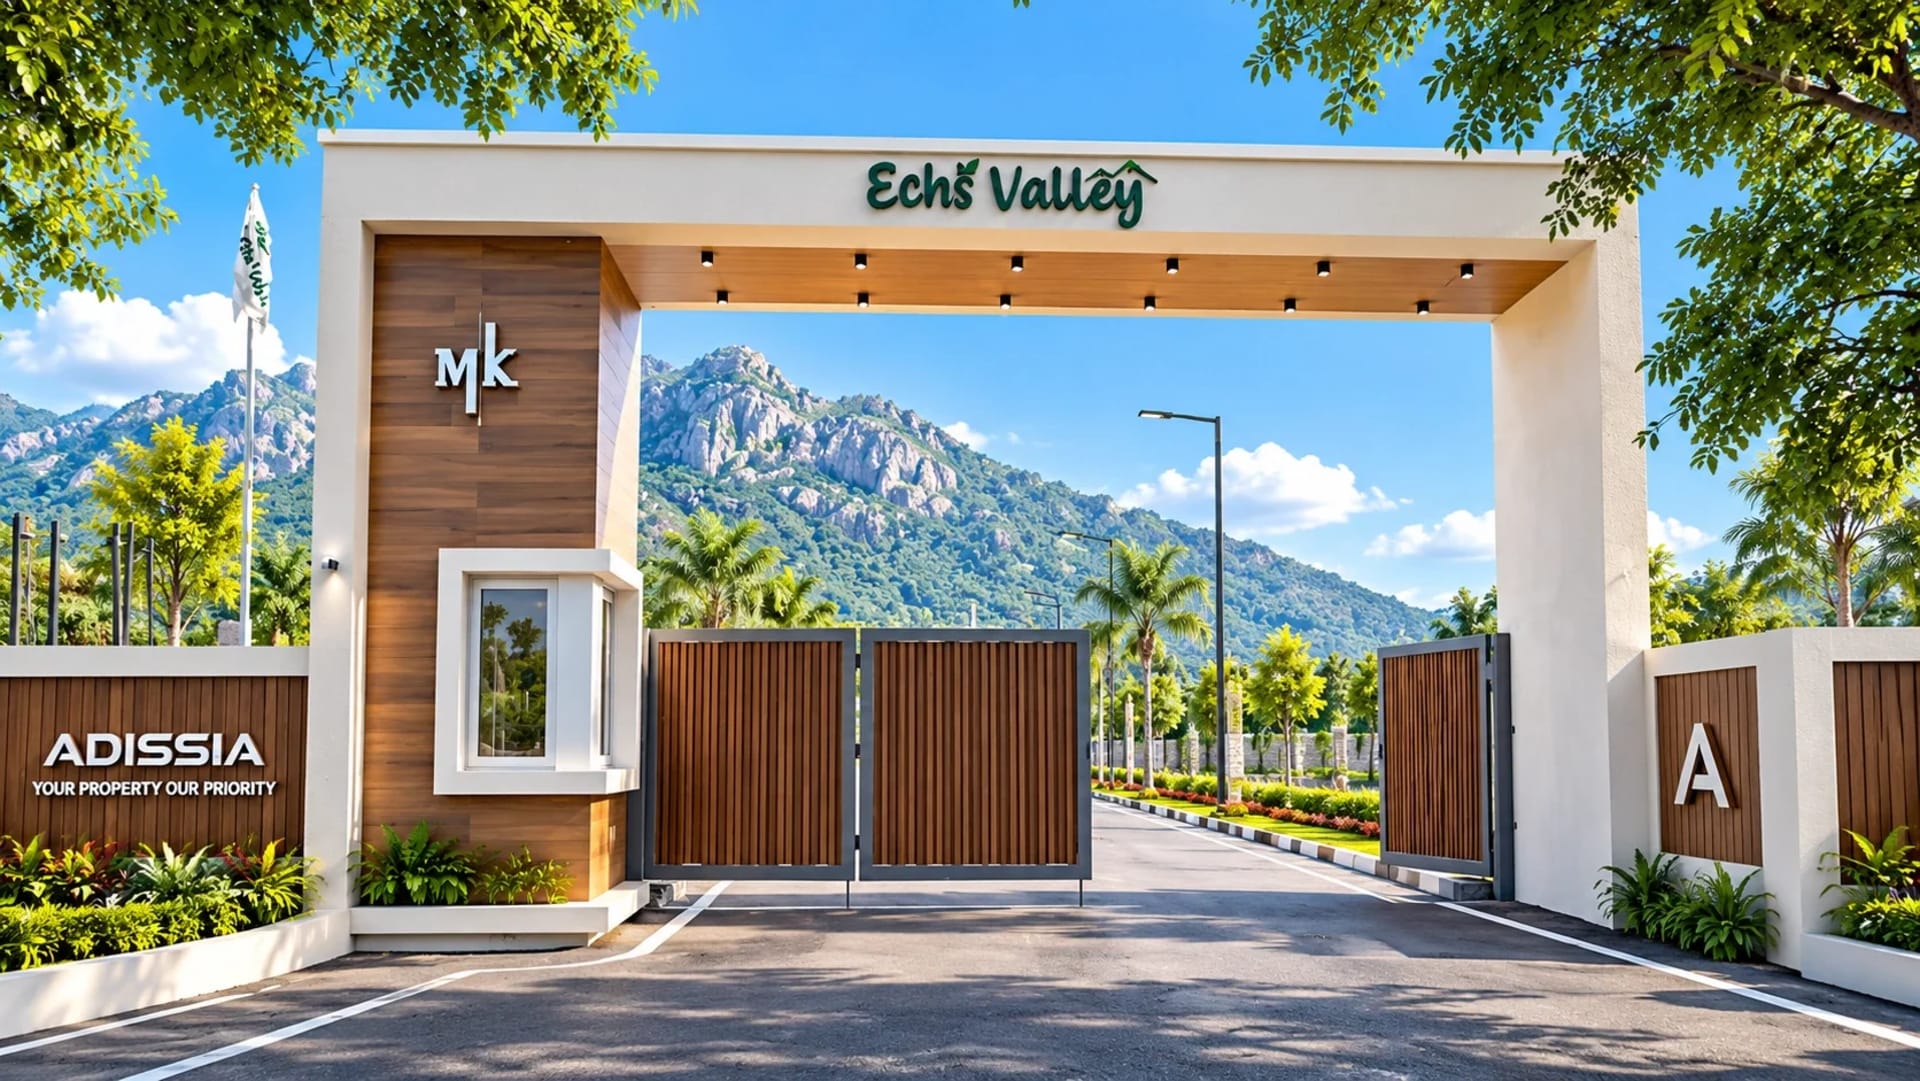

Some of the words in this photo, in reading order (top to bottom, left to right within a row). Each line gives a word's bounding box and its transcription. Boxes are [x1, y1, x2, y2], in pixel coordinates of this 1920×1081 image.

[867, 160, 976, 210] Echs
[989, 164, 1144, 229] Valley
[42, 732, 266, 767] ADISSIA
[1673, 722, 1731, 809] A
[31, 780, 76, 797] YOUR
[78, 780, 164, 797] PROPERTY
[165, 780, 200, 797] OUR
[202, 780, 278, 797] PRIORITY
